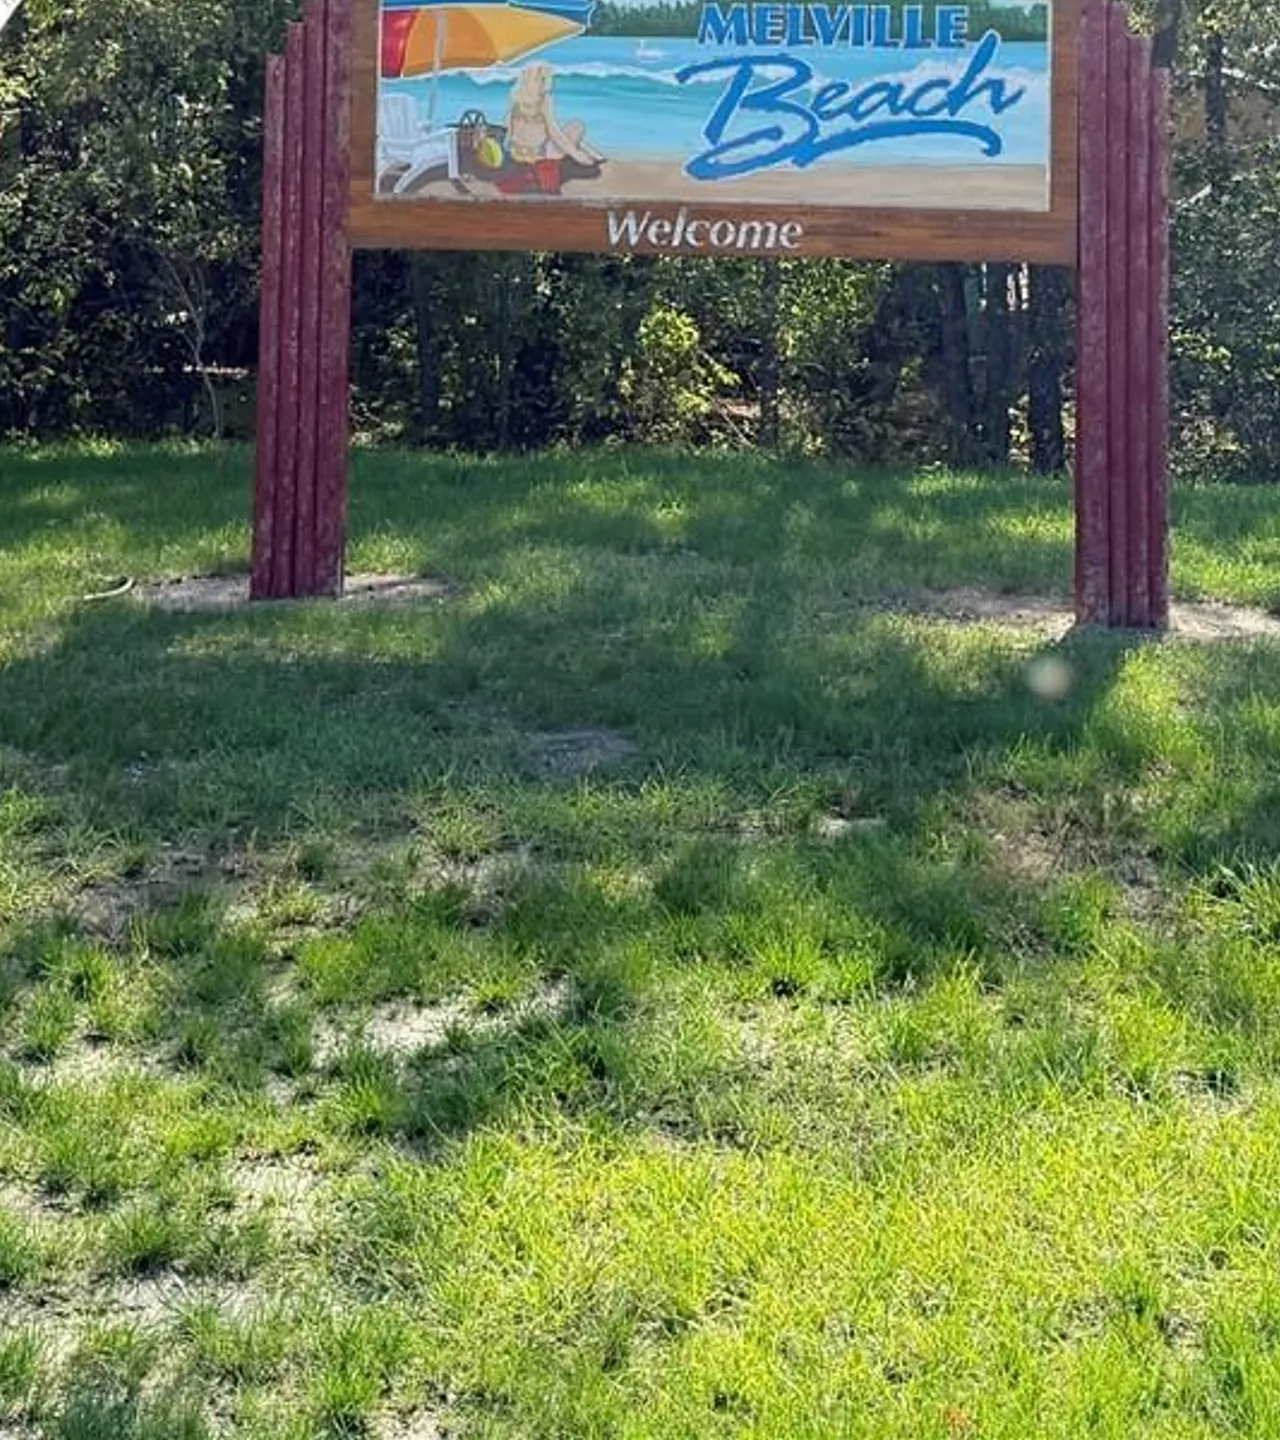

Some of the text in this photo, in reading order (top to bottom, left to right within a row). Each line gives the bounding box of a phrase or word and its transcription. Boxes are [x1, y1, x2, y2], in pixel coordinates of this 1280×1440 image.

[698, 2, 969, 50] MELVILLE
[674, 30, 1024, 181] Beach
[606, 209, 805, 251] Welcome
